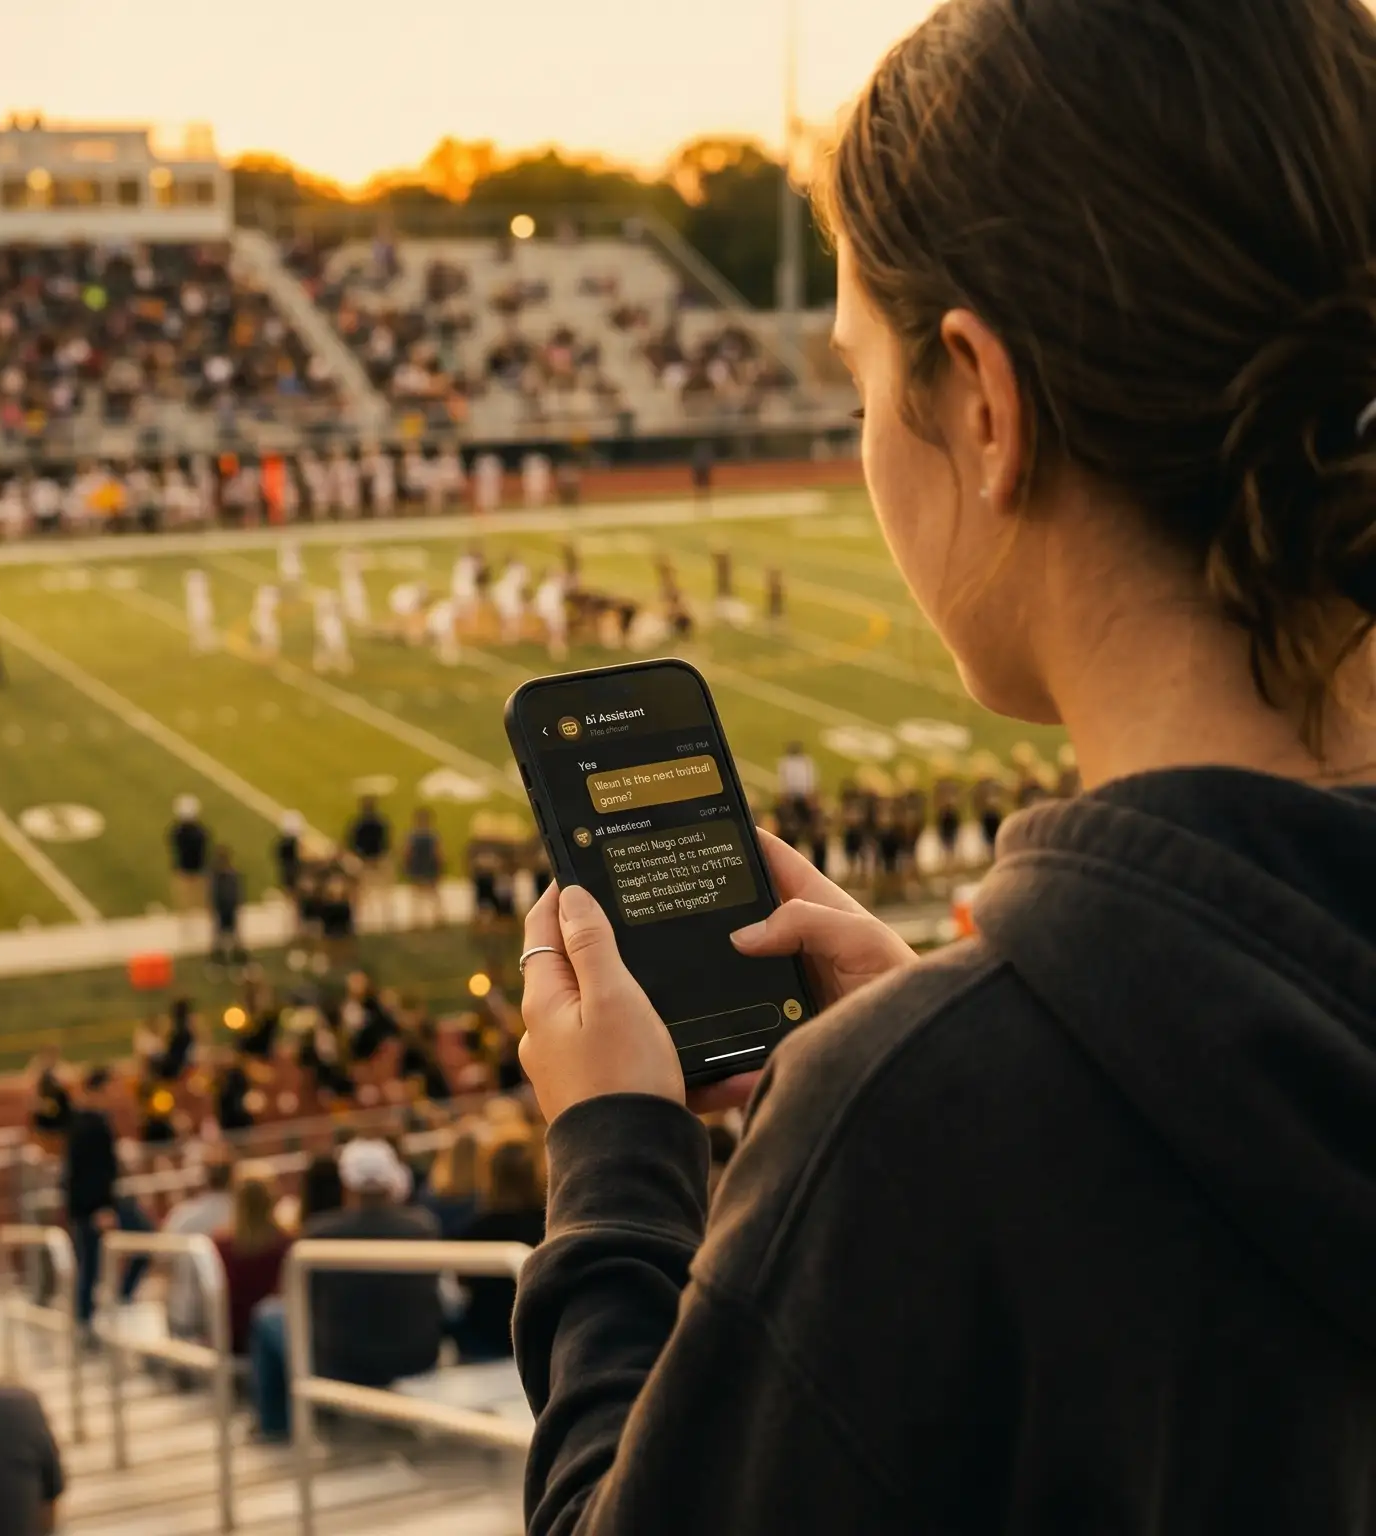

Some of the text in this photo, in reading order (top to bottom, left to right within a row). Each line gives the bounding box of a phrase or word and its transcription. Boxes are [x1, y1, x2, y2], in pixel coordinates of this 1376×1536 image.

[598, 707, 645, 723] Assistant
[578, 760, 598, 772] Yes
[633, 774, 651, 785] the
[652, 769, 675, 781] next
[600, 791, 633, 808] game?
